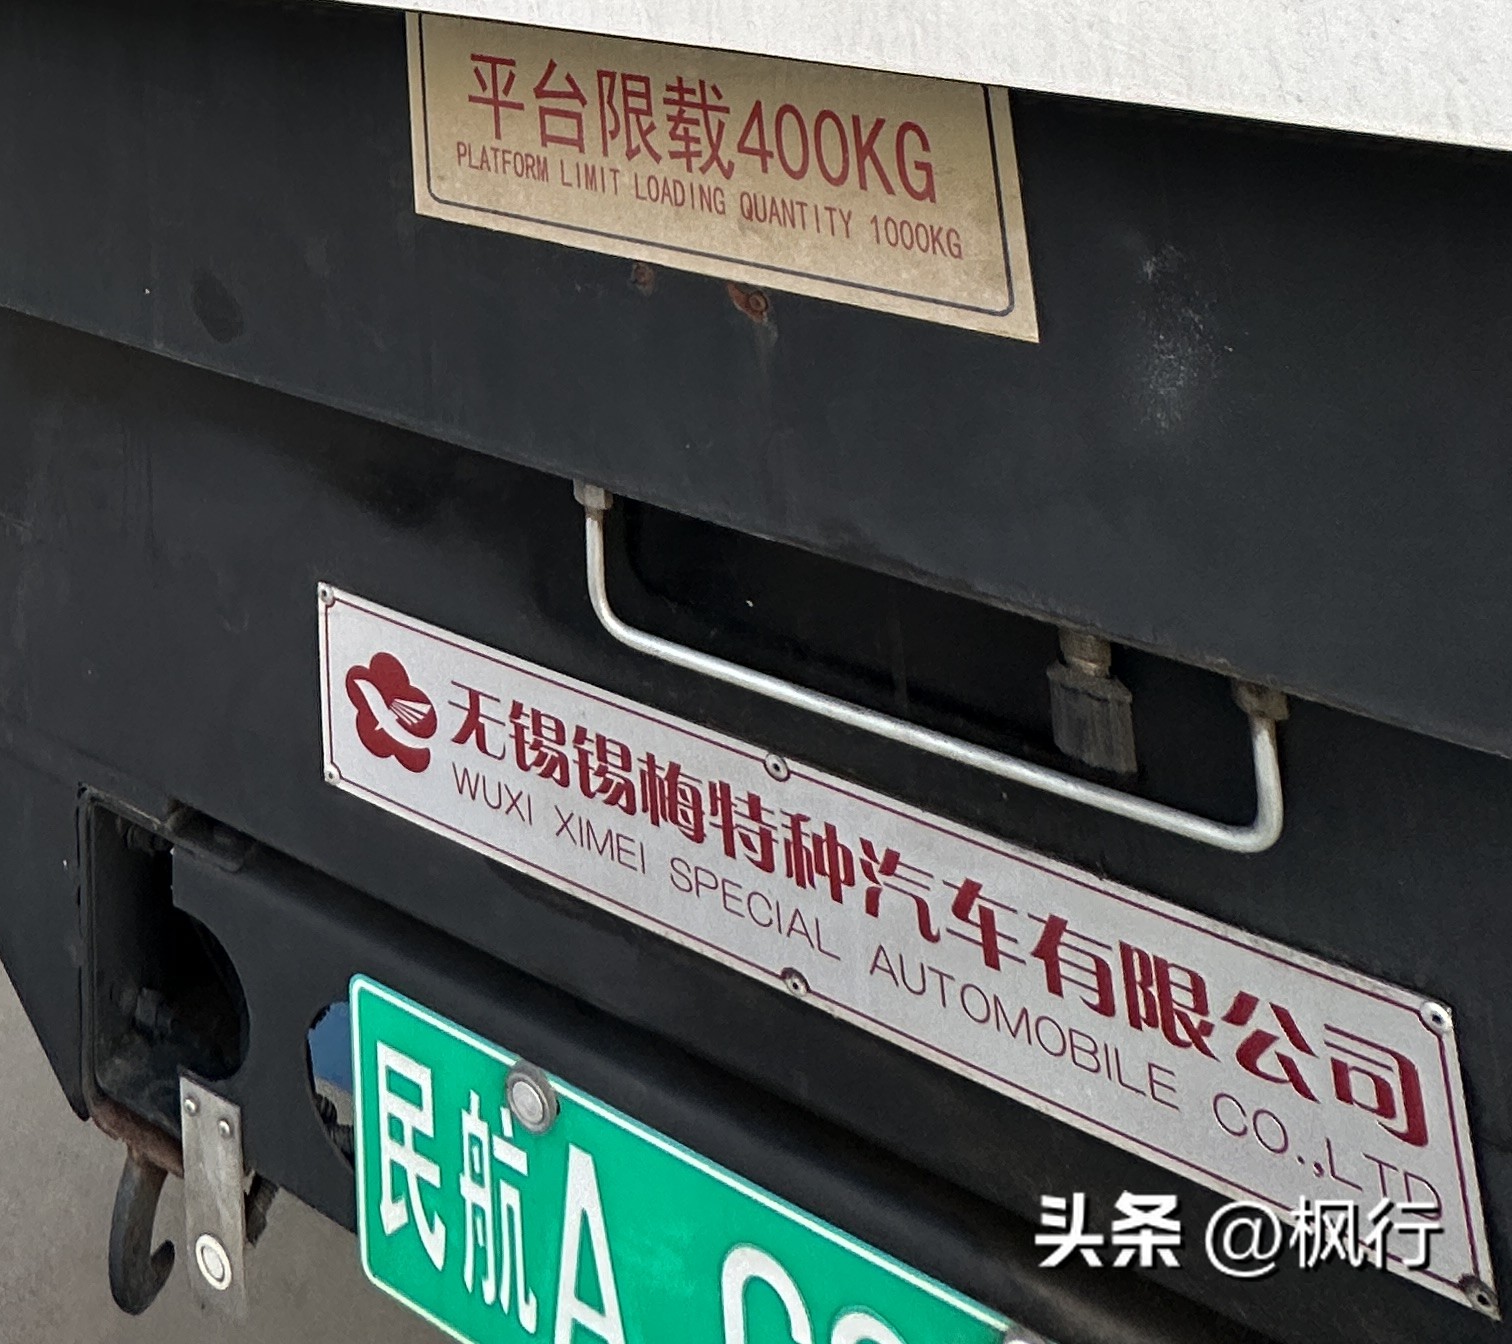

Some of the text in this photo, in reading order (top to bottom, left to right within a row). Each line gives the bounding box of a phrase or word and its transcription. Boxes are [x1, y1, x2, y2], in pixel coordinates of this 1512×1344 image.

[456, 141, 964, 260] PLATFORM LIMIT LOADING QUANTITY 1000KG
[466, 52, 939, 204] 平台限载400KG
[448, 679, 1430, 1147] 无锡锡梅特种汽车有限公司
[450, 762, 534, 827] WUXI
[554, 804, 647, 876] XIMEI
[669, 856, 842, 962] SPECIAL
[868, 944, 1181, 1112] AUTOMOBILE
